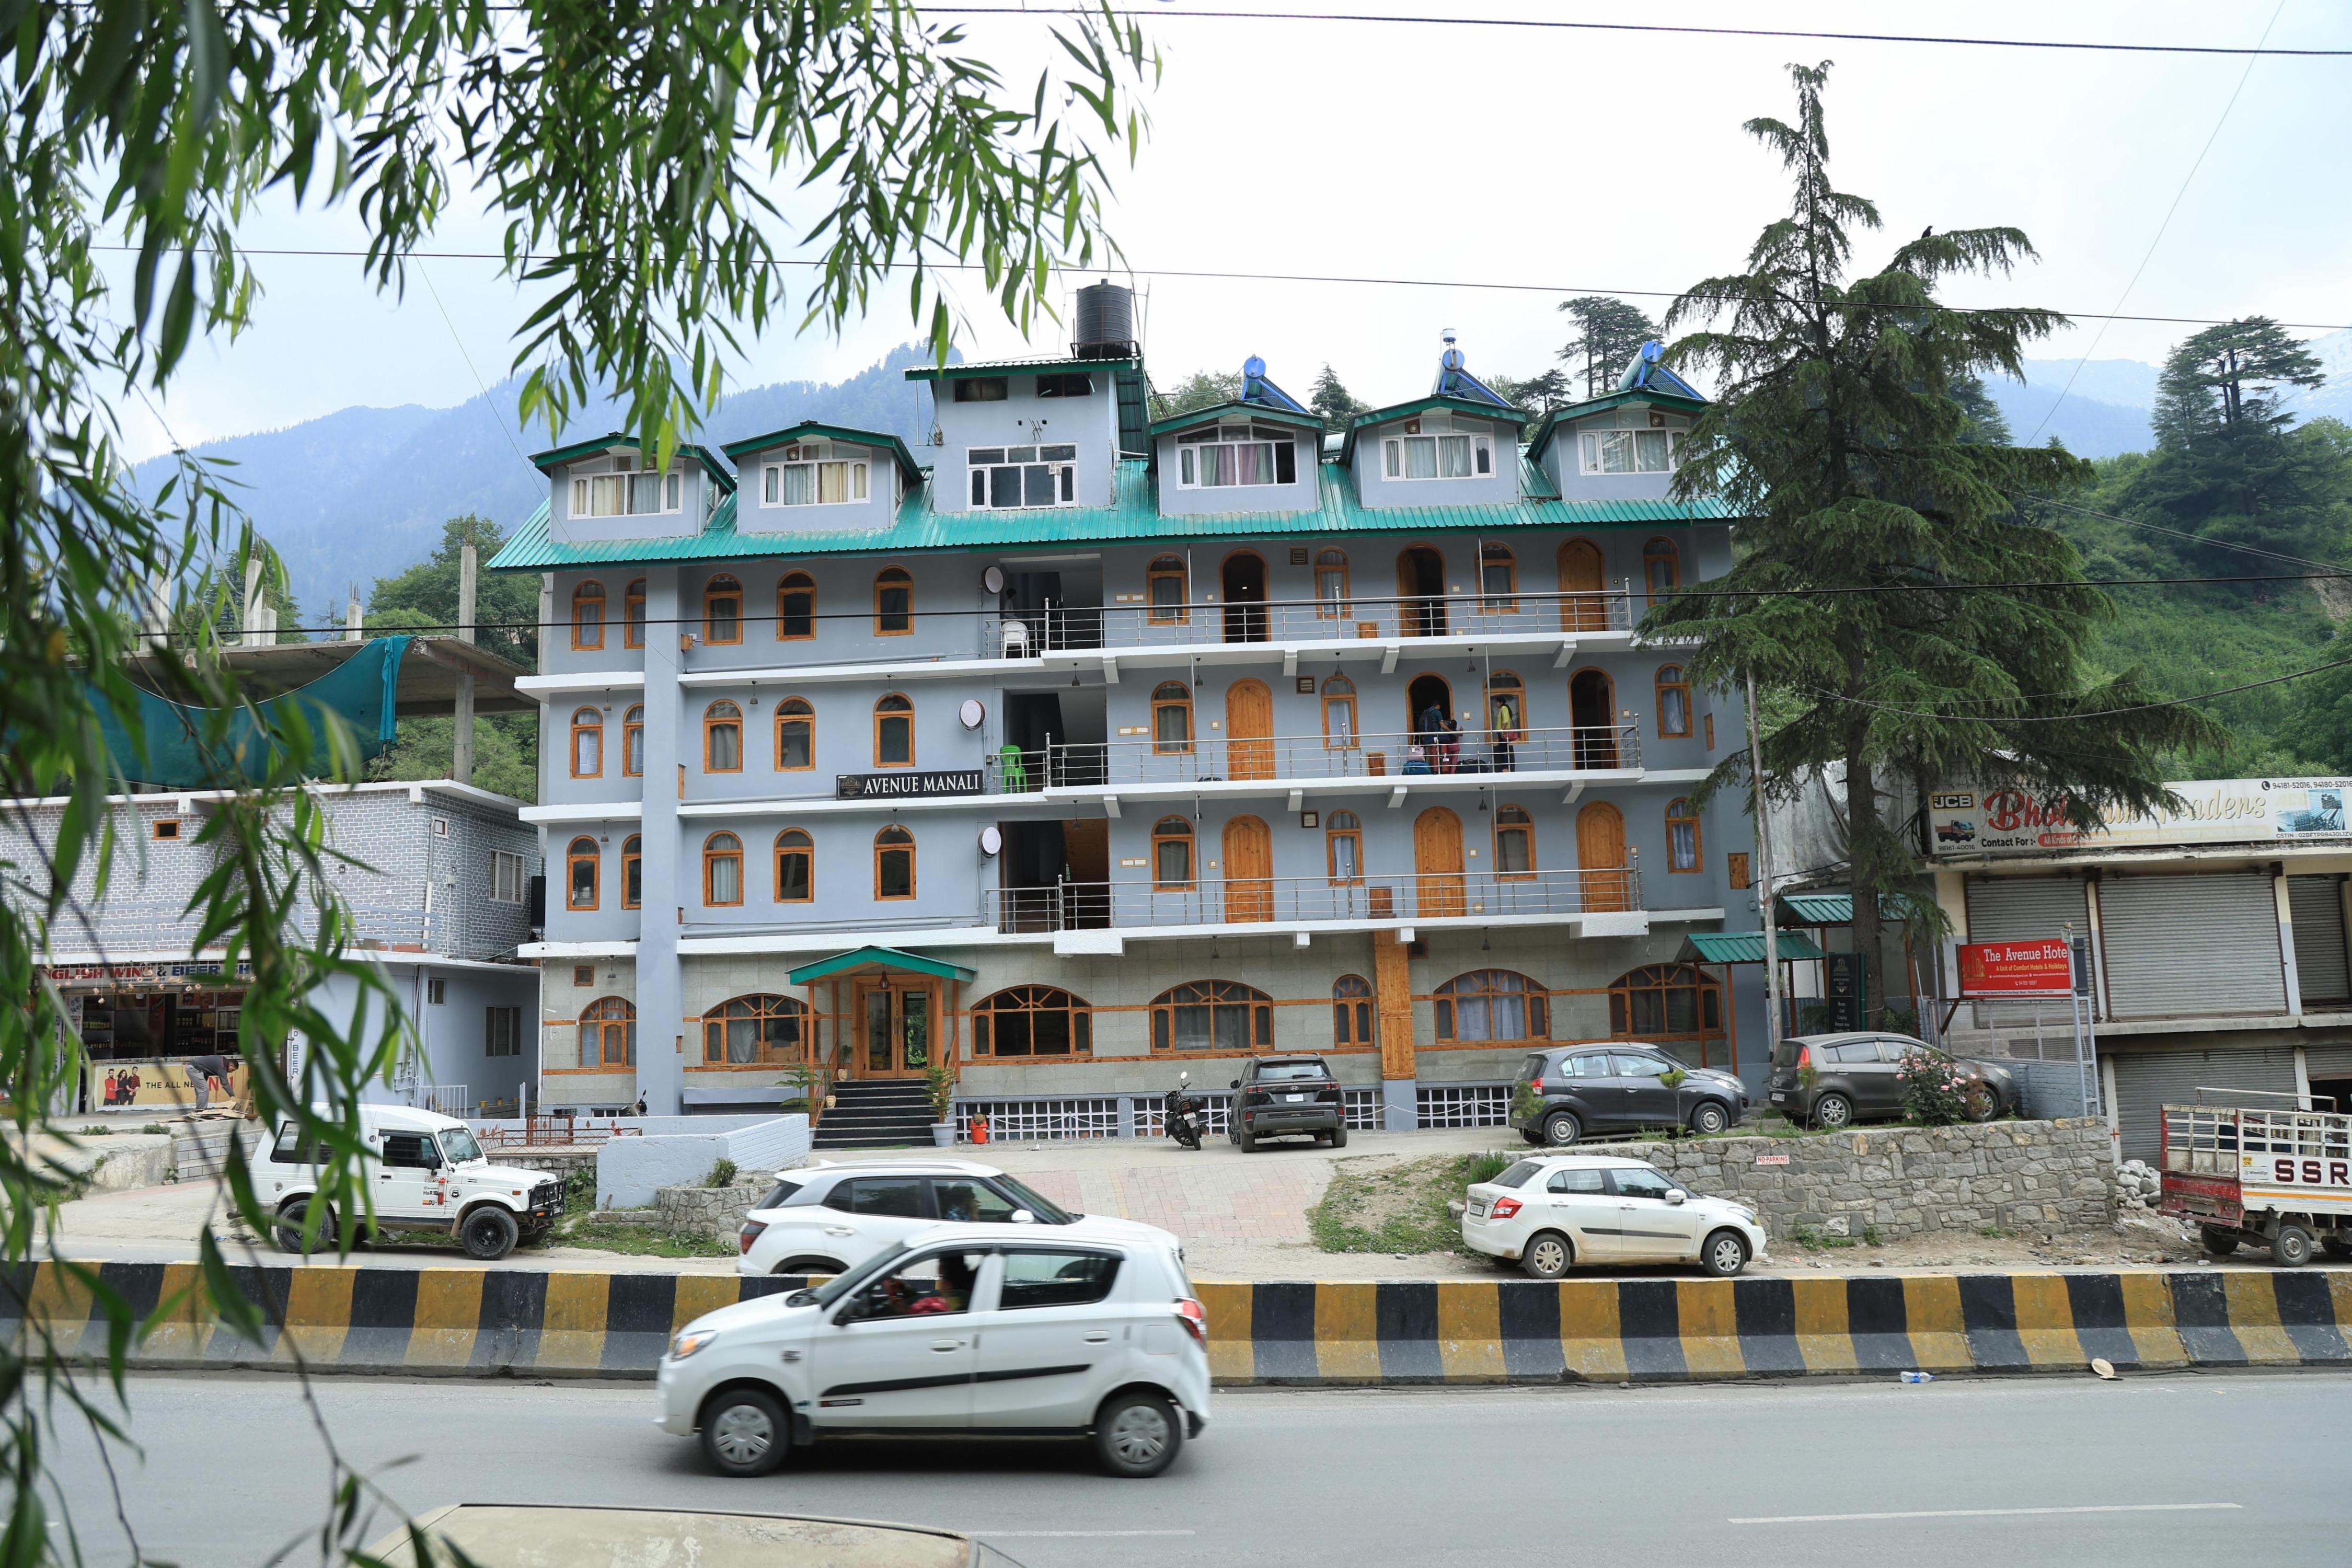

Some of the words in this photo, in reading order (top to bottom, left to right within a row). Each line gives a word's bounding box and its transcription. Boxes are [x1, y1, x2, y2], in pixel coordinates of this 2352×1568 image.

[863, 777, 919, 794] AVENUE
[923, 774, 979, 792] MANALI
[1934, 795, 1973, 808] JCB
[1984, 790, 2079, 831] Bhol
[1981, 838, 2013, 847] Contact
[2015, 837, 2028, 846] For
[2052, 836, 2066, 844] Kinds
[1984, 949, 2001, 962] The
[2005, 948, 2041, 961] Avenue
[2043, 945, 2068, 959] Hote
[42, 967, 104, 979] NGLISH
[157, 965, 167, 976] &
[172, 965, 221, 976] BEER
